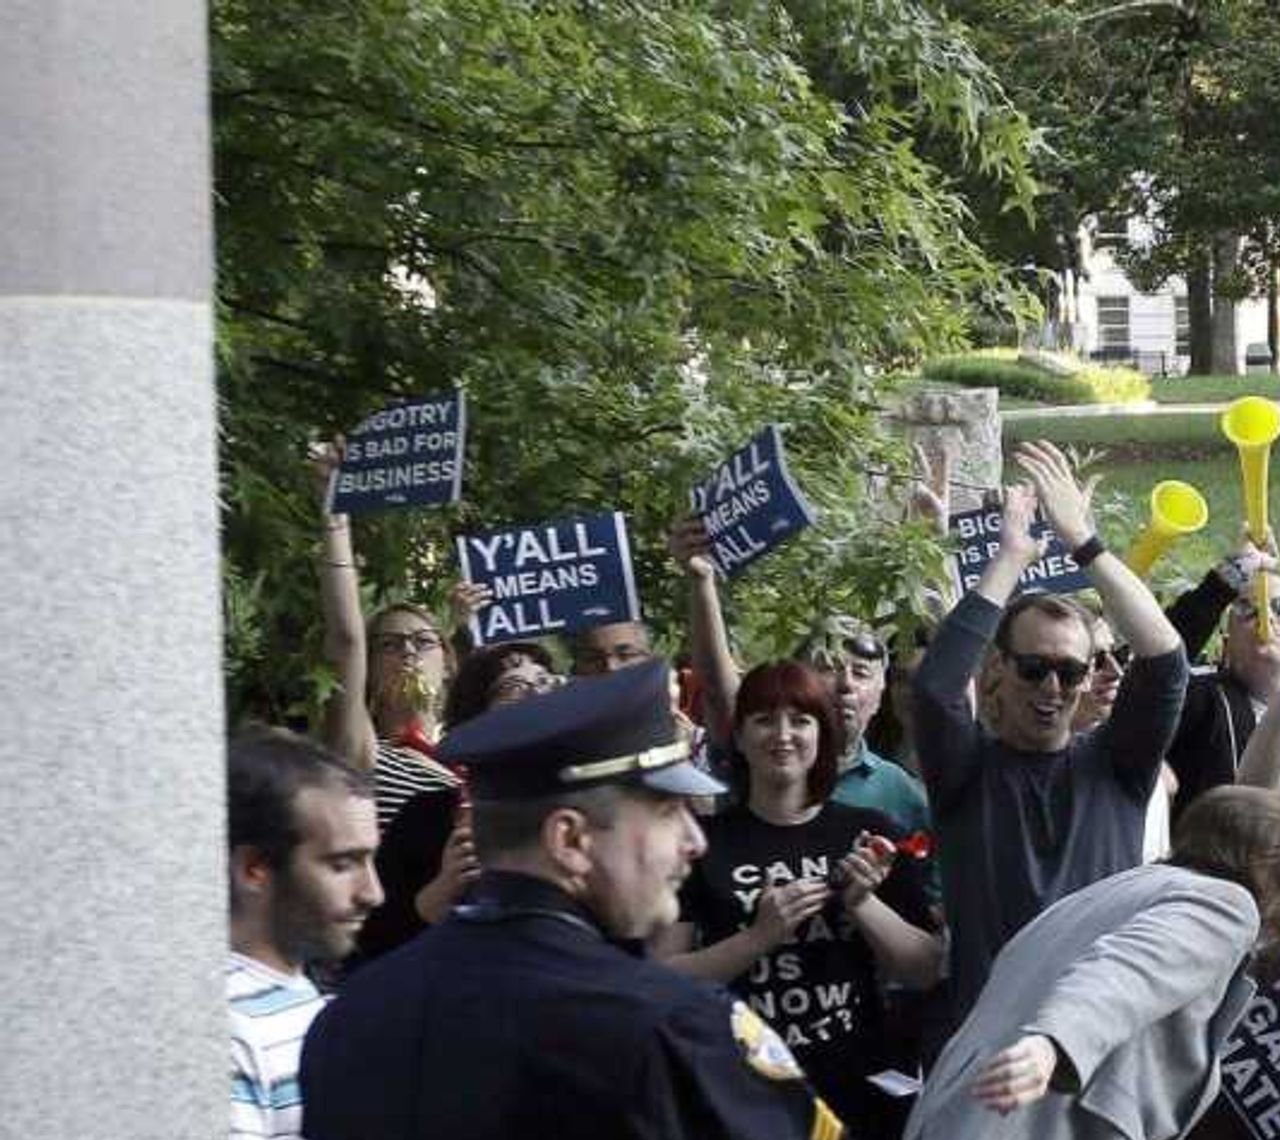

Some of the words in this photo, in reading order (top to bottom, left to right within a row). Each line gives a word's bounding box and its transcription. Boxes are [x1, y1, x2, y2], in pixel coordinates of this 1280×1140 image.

[365, 436, 409, 457] BAD
[414, 431, 457, 453] FOR
[338, 460, 455, 493] BUSINESS
[703, 480, 771, 537] MEANS
[470, 522, 608, 572] Y'ALL
[714, 525, 767, 571] ALL
[493, 563, 599, 599] MEANS
[485, 598, 567, 638] ALL
[731, 855, 829, 884] CAN
